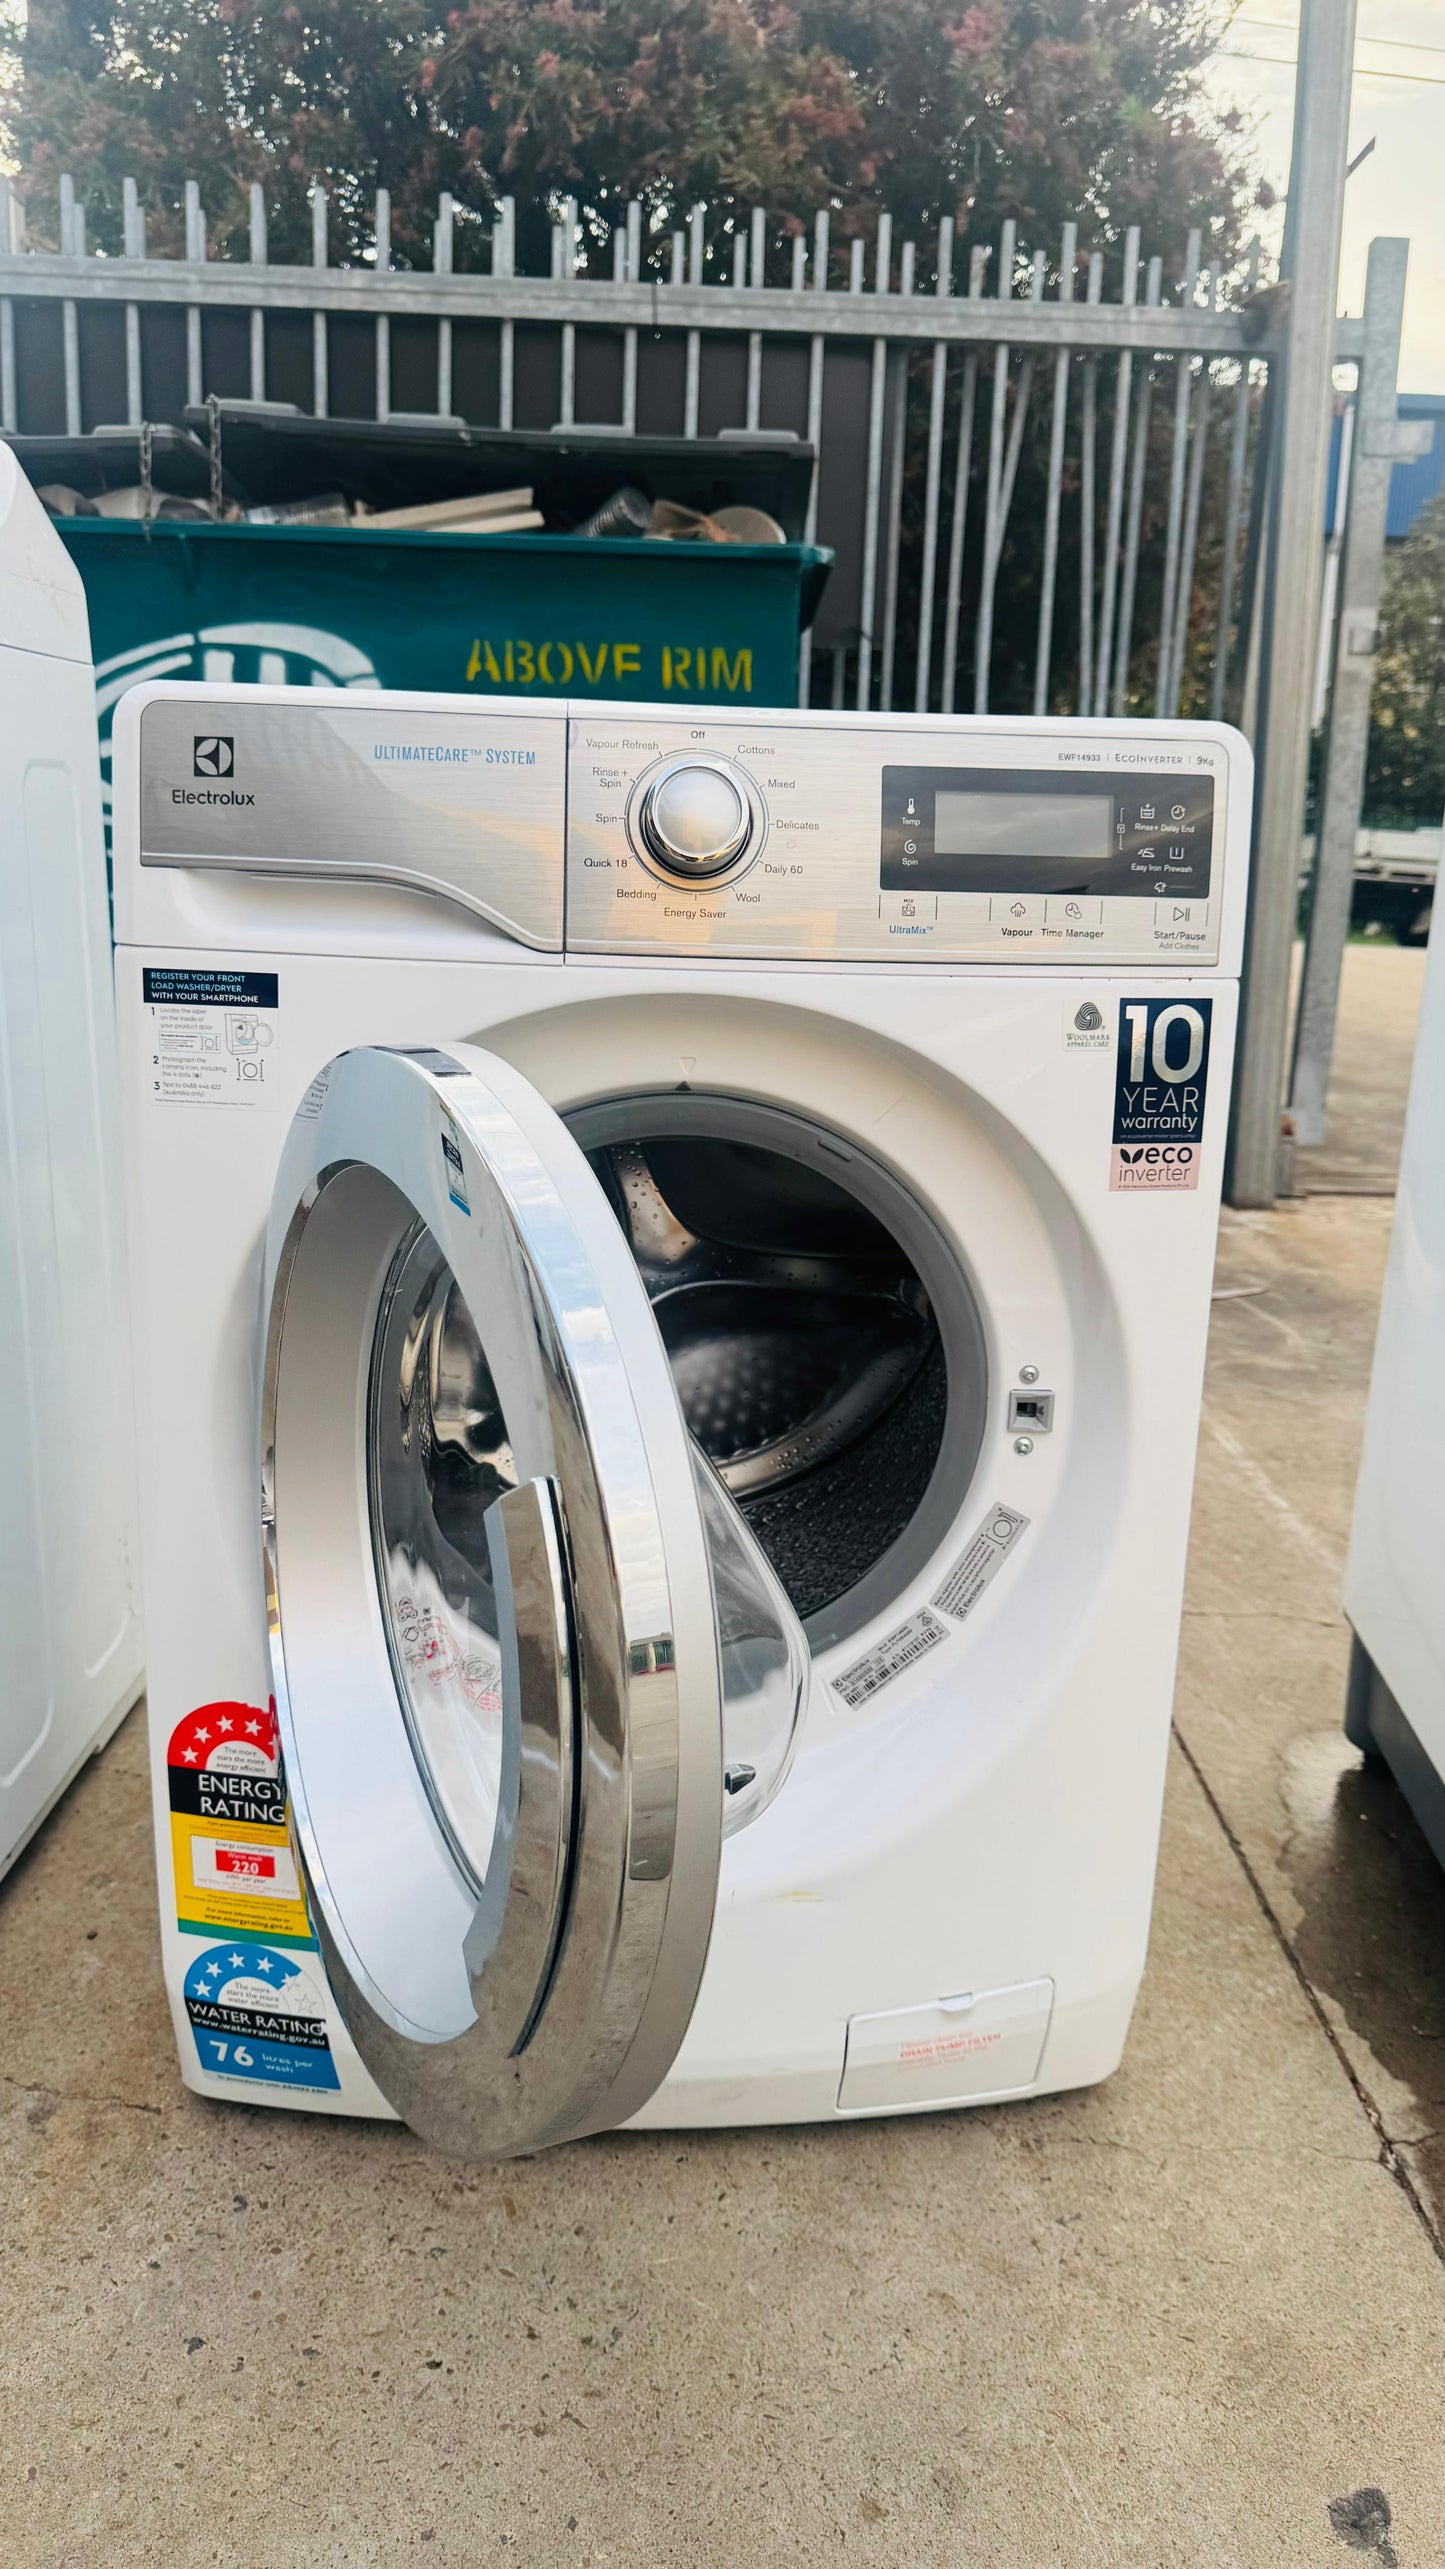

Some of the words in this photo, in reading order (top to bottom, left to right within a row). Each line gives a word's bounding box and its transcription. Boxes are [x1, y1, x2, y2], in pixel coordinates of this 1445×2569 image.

[662, 647, 752, 692] RIM
[690, 730, 706, 739] Off
[586, 739, 619, 749] Vapour
[622, 739, 659, 750] Refresh
[737, 744, 775, 755] Cottons
[1058, 753, 1100, 762] EWF14933
[1197, 756, 1214, 767] 9Kg
[592, 767, 619, 777] Rinse
[620, 769, 629, 777] +
[600, 778, 622, 789] Spin
[768, 778, 795, 789] Mixed
[172, 790, 255, 805] Electrolux
[595, 813, 618, 824] Spin
[901, 817, 921, 827] Temp
[776, 819, 820, 830] Delicates
[1161, 824, 1180, 834] Delay
[1181, 825, 1195, 833] End
[584, 858, 612, 869] Quick
[615, 859, 628, 868] 18
[902, 857, 918, 867] Spin
[764, 864, 788, 876] Daily
[790, 865, 803, 875] 60
[1131, 863, 1147, 872] Easy
[1148, 864, 1162, 872] Iron
[1163, 864, 1193, 873] Prewash
[616, 889, 657, 901] Bedding
[736, 893, 761, 904] Wool
[664, 907, 697, 919] Energy
[699, 909, 727, 919] Saver
[1001, 928, 1033, 938] Vapour
[1041, 928, 1063, 938] Time
[1066, 929, 1104, 940] Manager
[1154, 930, 1206, 941] Start/Pause
[1174, 942, 1199, 950] Clothes
[151, 971, 189, 981] REGISTER
[191, 974, 215, 982] YOUR
[217, 975, 245, 984] FRONT
[151, 982, 174, 990] LOAD
[176, 983, 242, 993] WASHER/DRYER
[151, 992, 173, 1000] WITH
[175, 993, 199, 1001] YOUR
[200, 994, 259, 1004] SMARTPHONE
[151, 1007, 155, 1015] 1
[1125, 1003, 1205, 1084] 10
[153, 1056, 159, 1064] 2
[154, 1082, 160, 1090] 3
[1122, 1087, 1199, 1113] YEAR
[1121, 1113, 1198, 1132] warranty
[1145, 1147, 1193, 1164] eco
[1119, 1164, 1190, 1181] inverter
[961, 1577, 986, 1608] Electrolux
[224, 1746, 237, 1754] The
[217, 1762, 238, 1772] energy
[240, 1764, 266, 1773] efficient
[198, 1774, 281, 1800] ENERGY
[201, 1796, 285, 1823] RATING
[232, 1860, 259, 1874] 220
[205, 1914, 293, 1930] www.energyrating.gov.au
[235, 1982, 249, 1990] The
[250, 1985, 270, 1994] more
[251, 2000, 279, 2009] efficient
[188, 2002, 251, 2025] WATER
[255, 2015, 326, 2036] RATING
[192, 2016, 325, 2046] www.waterrating.gov.au
[209, 2040, 254, 2067] 76
[262, 2053, 290, 2065] litres
[294, 2060, 313, 2068] per
[265, 2064, 294, 2073] wash
